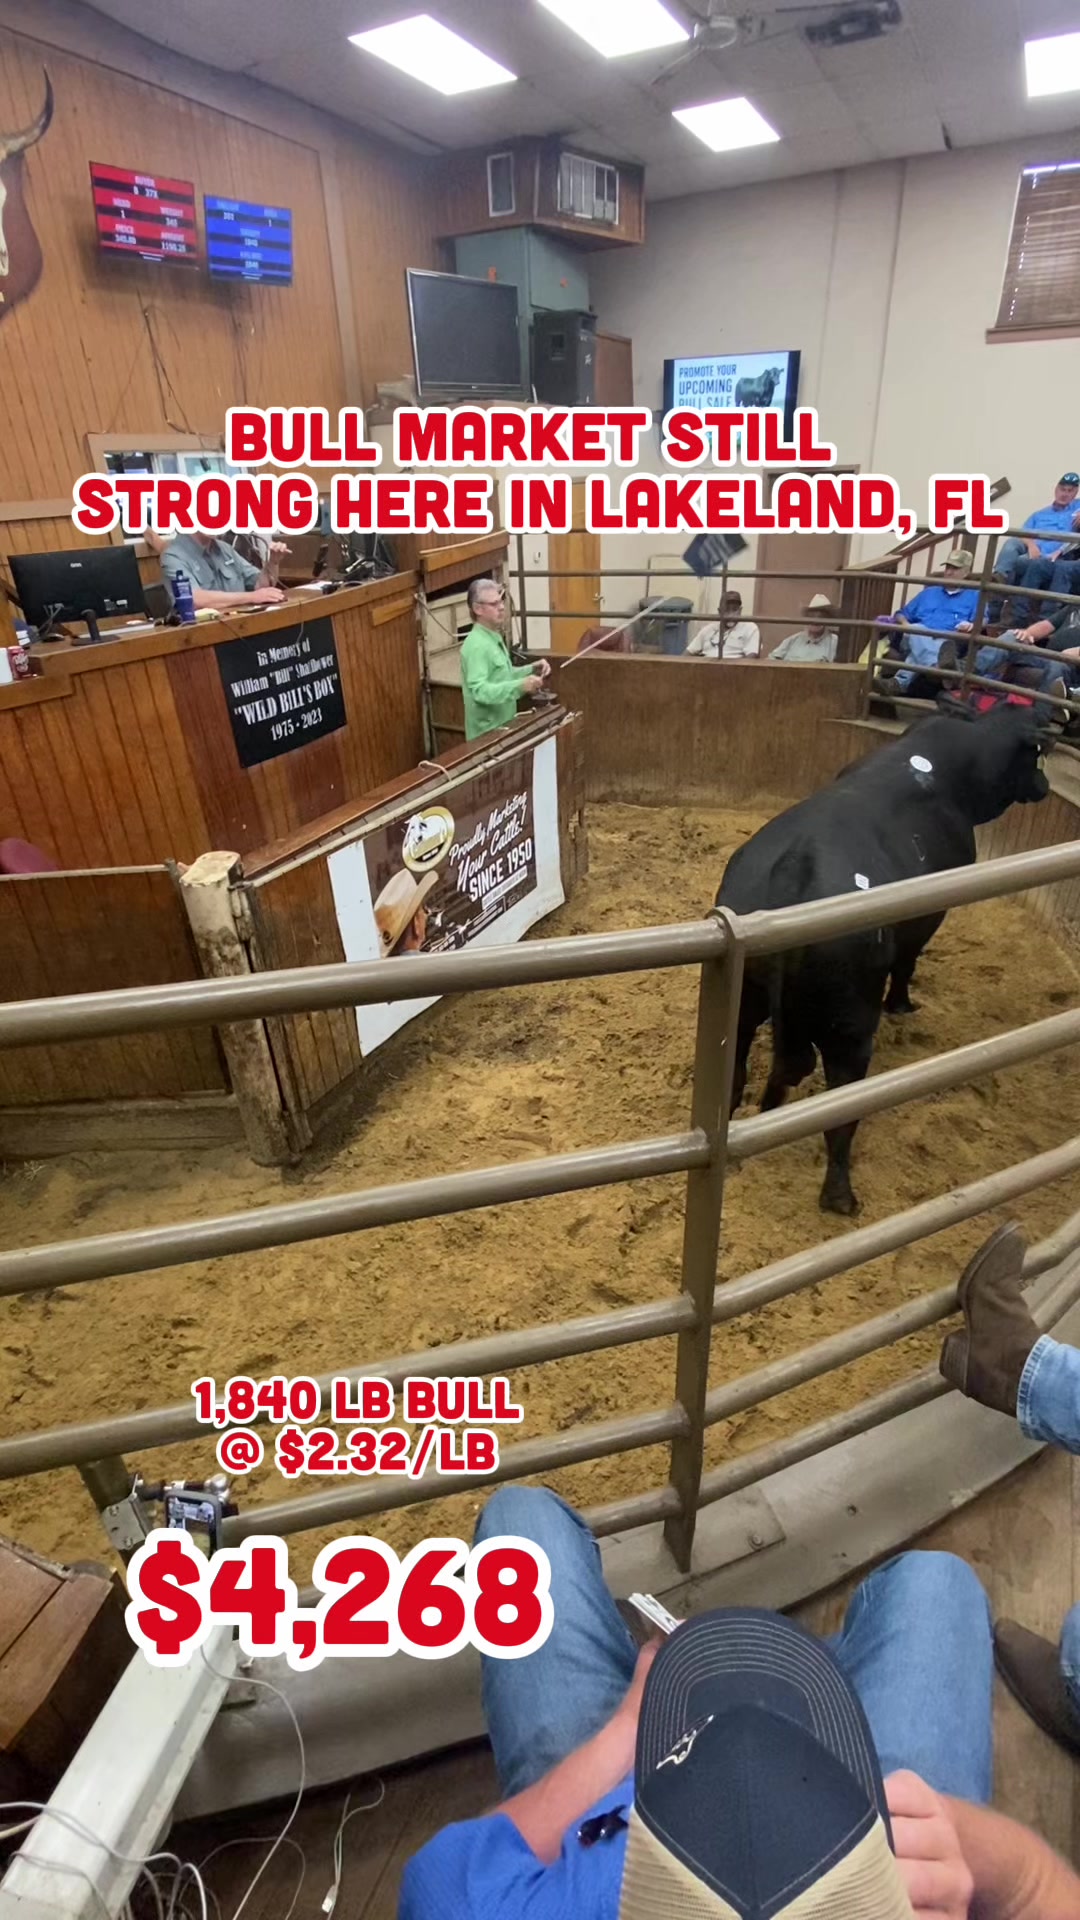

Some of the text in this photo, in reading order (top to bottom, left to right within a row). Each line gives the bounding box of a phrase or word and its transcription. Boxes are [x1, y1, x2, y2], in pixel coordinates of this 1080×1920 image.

[678, 378, 733, 396] UPCOMING
[679, 364, 737, 378] PROMOTE YOUR
[302, 637, 311, 653] of
[230, 676, 269, 698] William
[234, 673, 338, 726] "WILD BILL'S BOX"
[270, 718, 295, 741] 1975
[301, 707, 324, 729] 2023
[449, 791, 527, 866] Proudly Marketing
[456, 849, 488, 892] Your
[469, 857, 505, 902] SINCE
[507, 837, 532, 874] 1950
